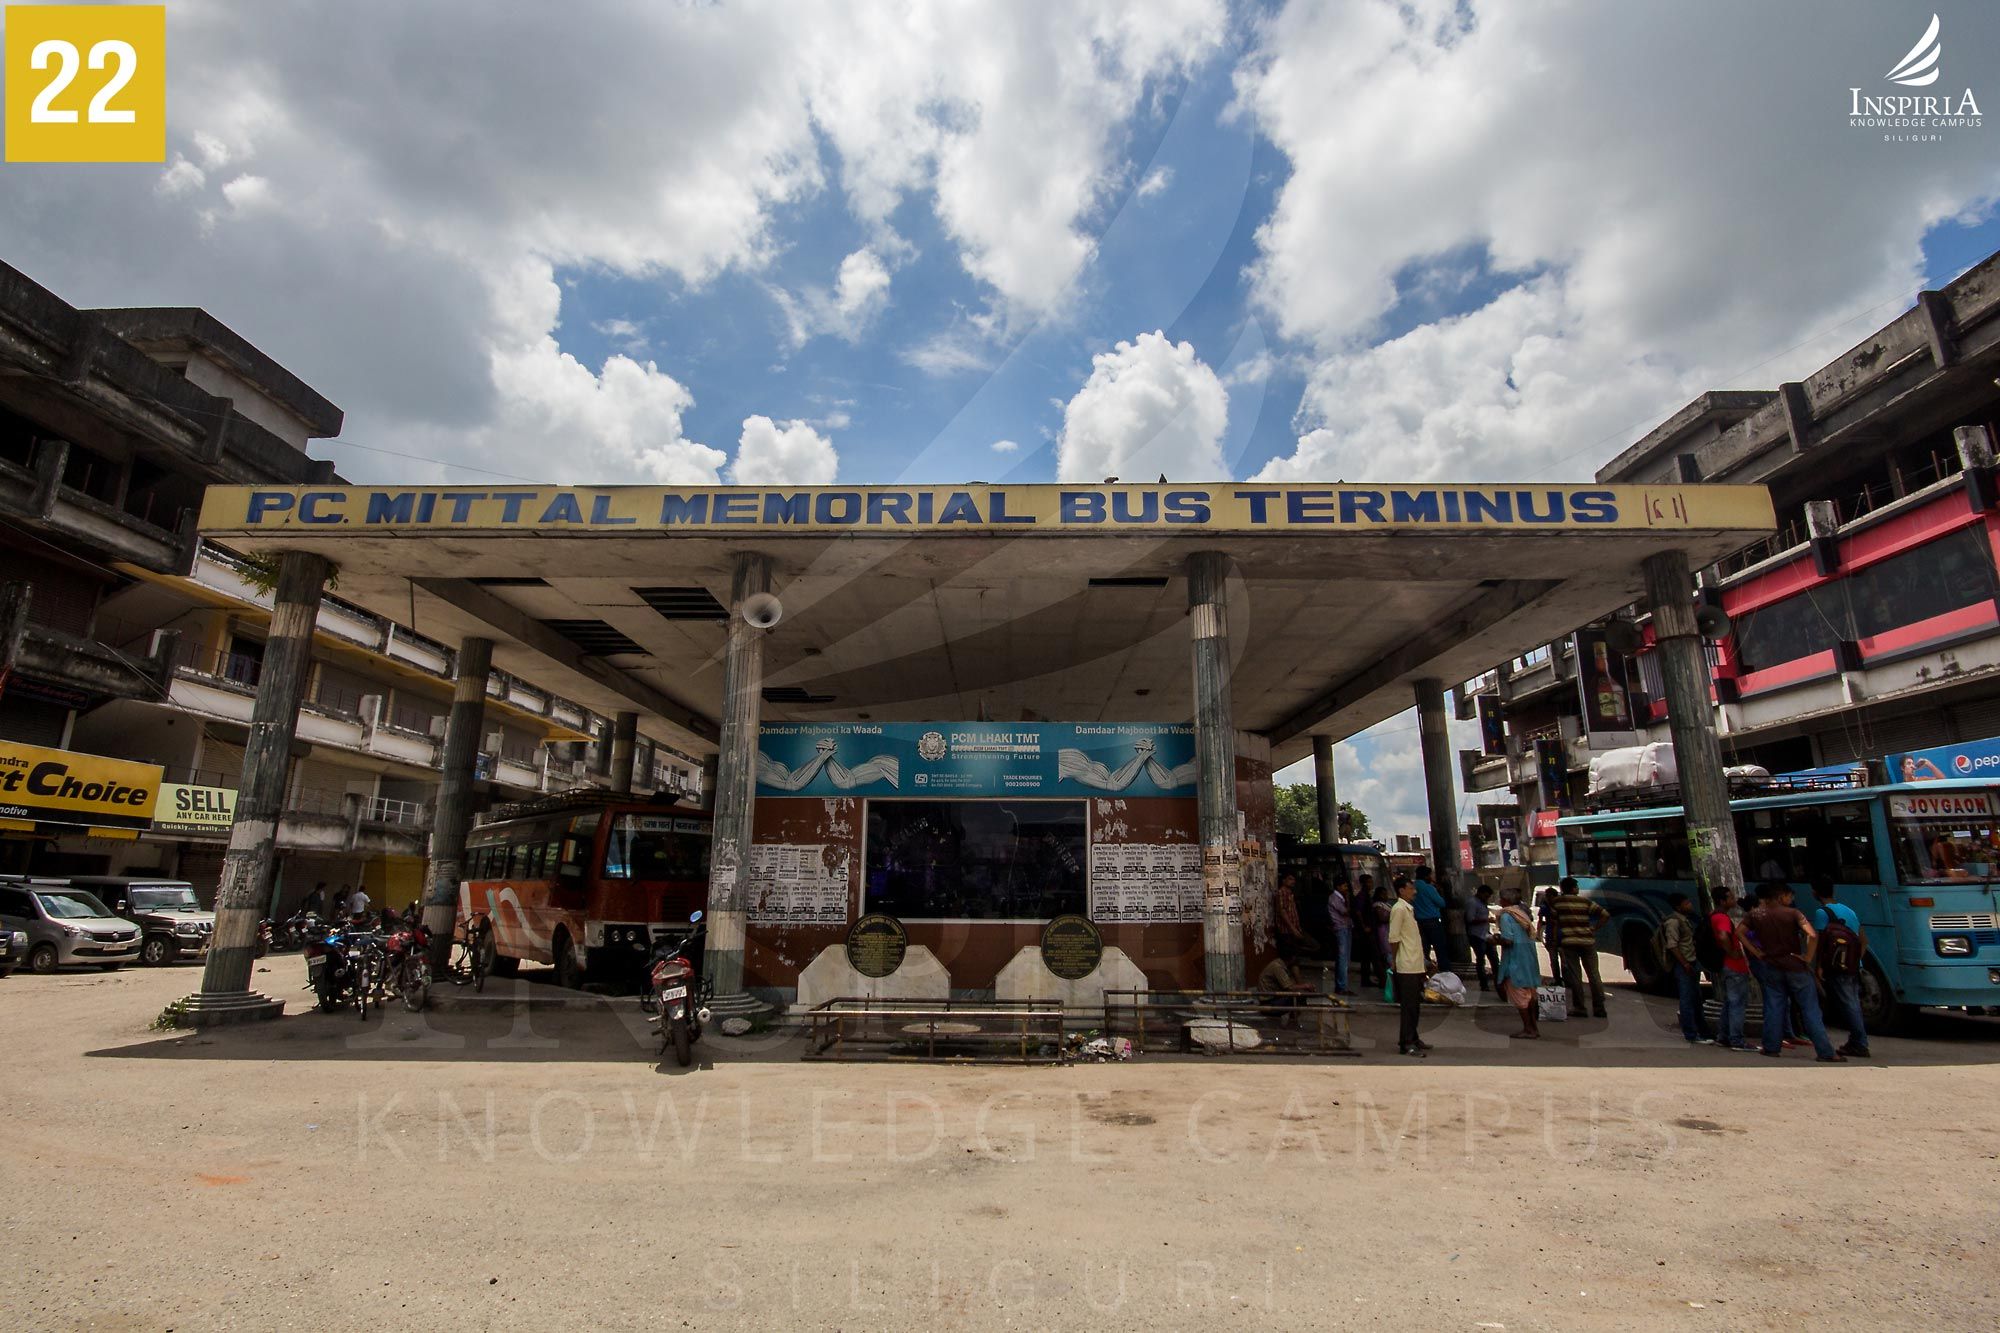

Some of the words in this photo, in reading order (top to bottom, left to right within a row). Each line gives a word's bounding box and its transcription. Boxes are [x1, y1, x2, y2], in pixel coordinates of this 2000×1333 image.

[366, 492, 638, 524] MITTAL
[660, 492, 1036, 524] MEMORIAL
[1059, 491, 1213, 524] BUS
[1234, 491, 1619, 524] TERMINUS
[759, 726, 798, 735] Damdaar
[800, 726, 838, 736] Majbooti
[841, 726, 851, 735] ka
[853, 726, 882, 735] Waada
[1075, 726, 1115, 735] Damdaar
[1117, 726, 1156, 736] Majbooti
[1158, 726, 1169, 735] ka
[951, 733, 976, 744] PCM
[980, 733, 1012, 744] LHAKI
[1016, 733, 1040, 744] TMT
[0, 770, 25, 792] t
[27, 761, 149, 806] Choice
[176, 788, 231, 813] SELL
[177, 812, 193, 820] ANY
[195, 812, 210, 820] CAR
